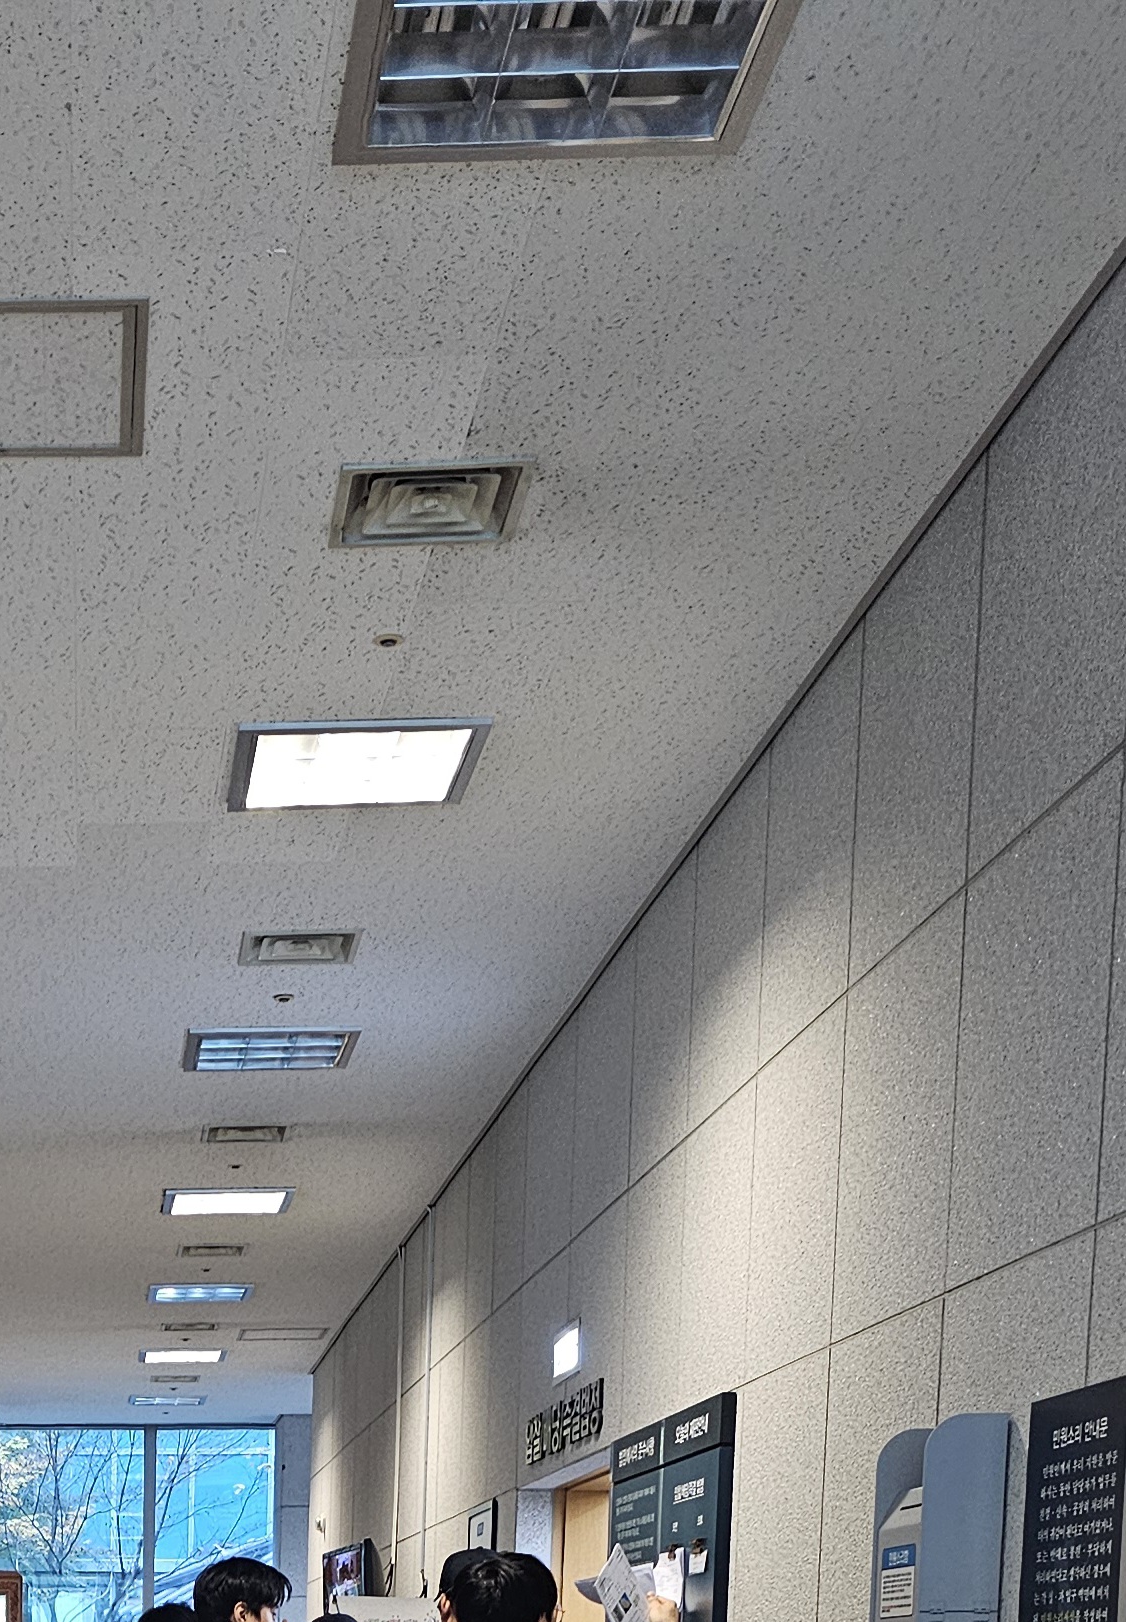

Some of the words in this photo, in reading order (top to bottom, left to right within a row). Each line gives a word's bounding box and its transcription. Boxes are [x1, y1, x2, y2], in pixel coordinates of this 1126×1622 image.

[1052, 1422, 1083, 1450] 민원소리
[1084, 1416, 1108, 1442] 안내문
[1072, 1456, 1083, 1472] 우리
[1085, 1454, 1103, 1470] 지원을
[1105, 1450, 1118, 1466] 방문
[1040, 1485, 1057, 1500] 하시는
[1059, 1482, 1070, 1497] 동안
[1072, 1476, 1096, 1495] 담당자가
[1097, 1472, 1116, 1489] 업무를
[1091, 1494, 1115, 1512] 처리하여
[1050, 1547, 1067, 1561] 반대로
[1069, 1563, 1091, 1581] 생각하신
[1065, 1588, 1077, 1603] 입구
[1078, 1586, 1096, 1602] 벽면에
[1083, 1606, 1108, 1622] 작성하여
